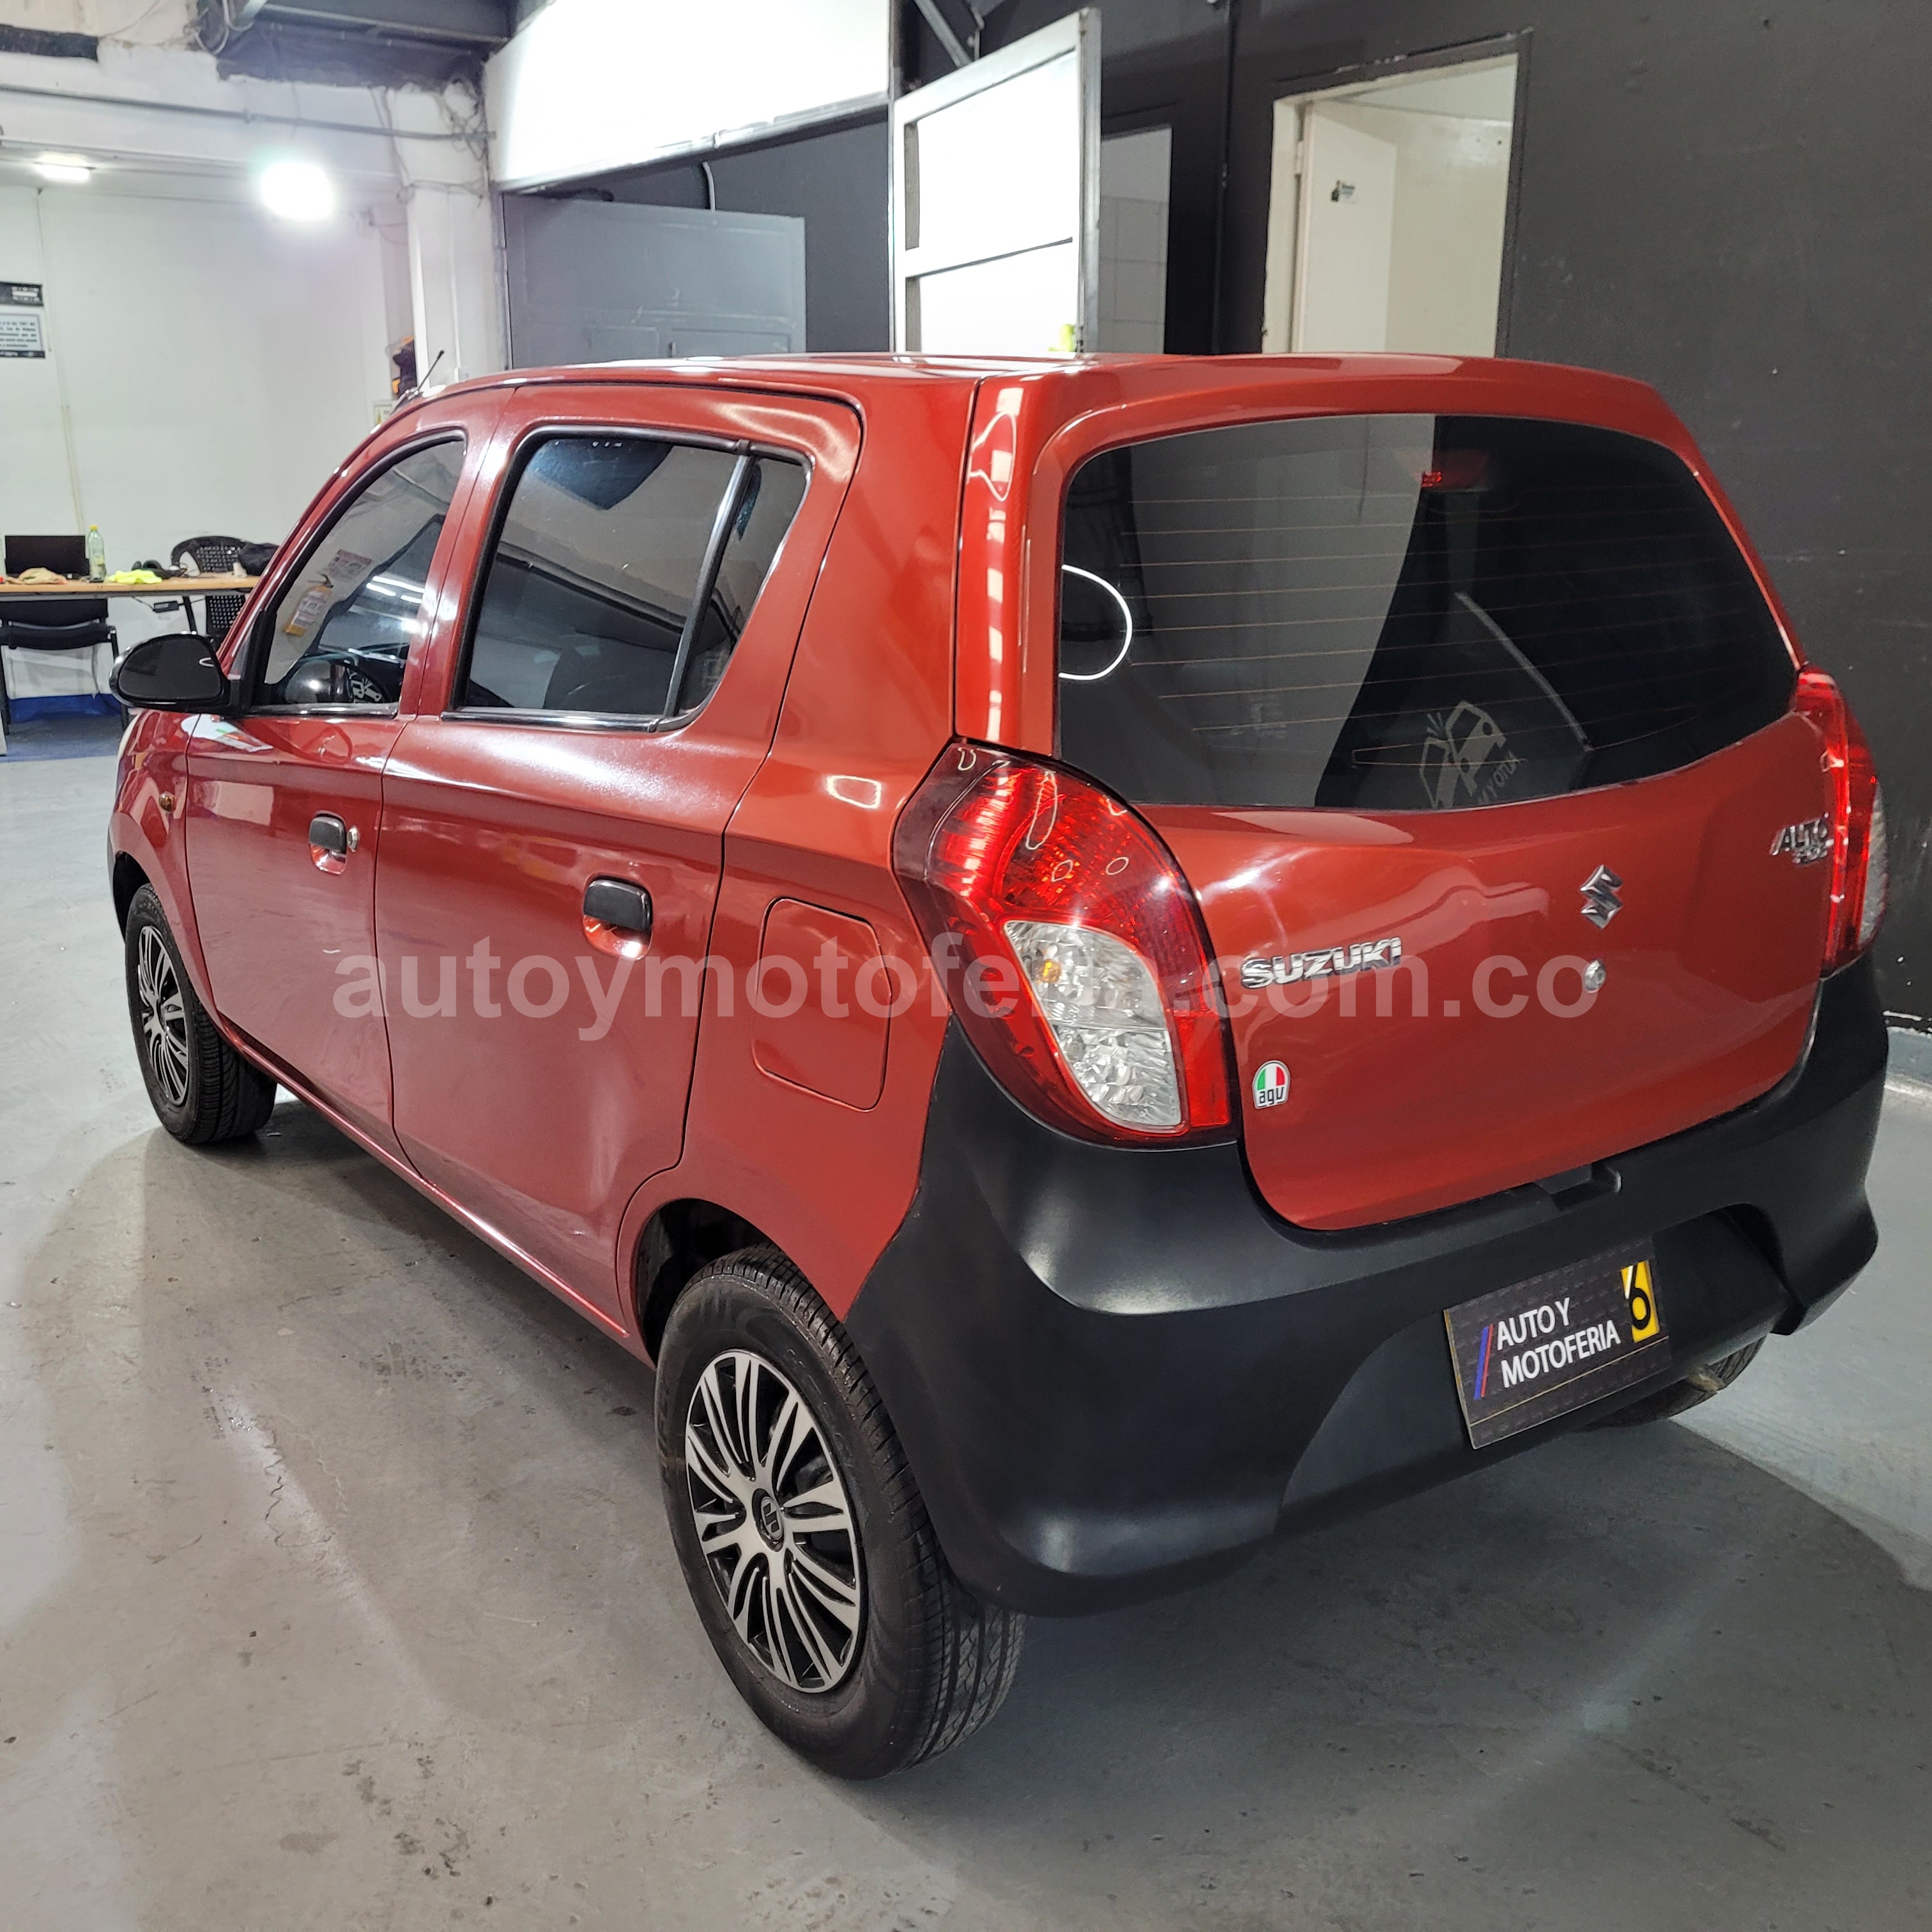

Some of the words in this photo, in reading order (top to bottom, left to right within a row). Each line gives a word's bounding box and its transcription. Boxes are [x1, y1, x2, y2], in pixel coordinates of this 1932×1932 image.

[1241, 937, 1402, 989] SUZUKI
[1259, 1086, 1285, 1105] agv
[1497, 1304, 1556, 1351] AUTO
[1555, 1297, 1571, 1326] Y
[1500, 1319, 1621, 1388] MOTOFERIA
